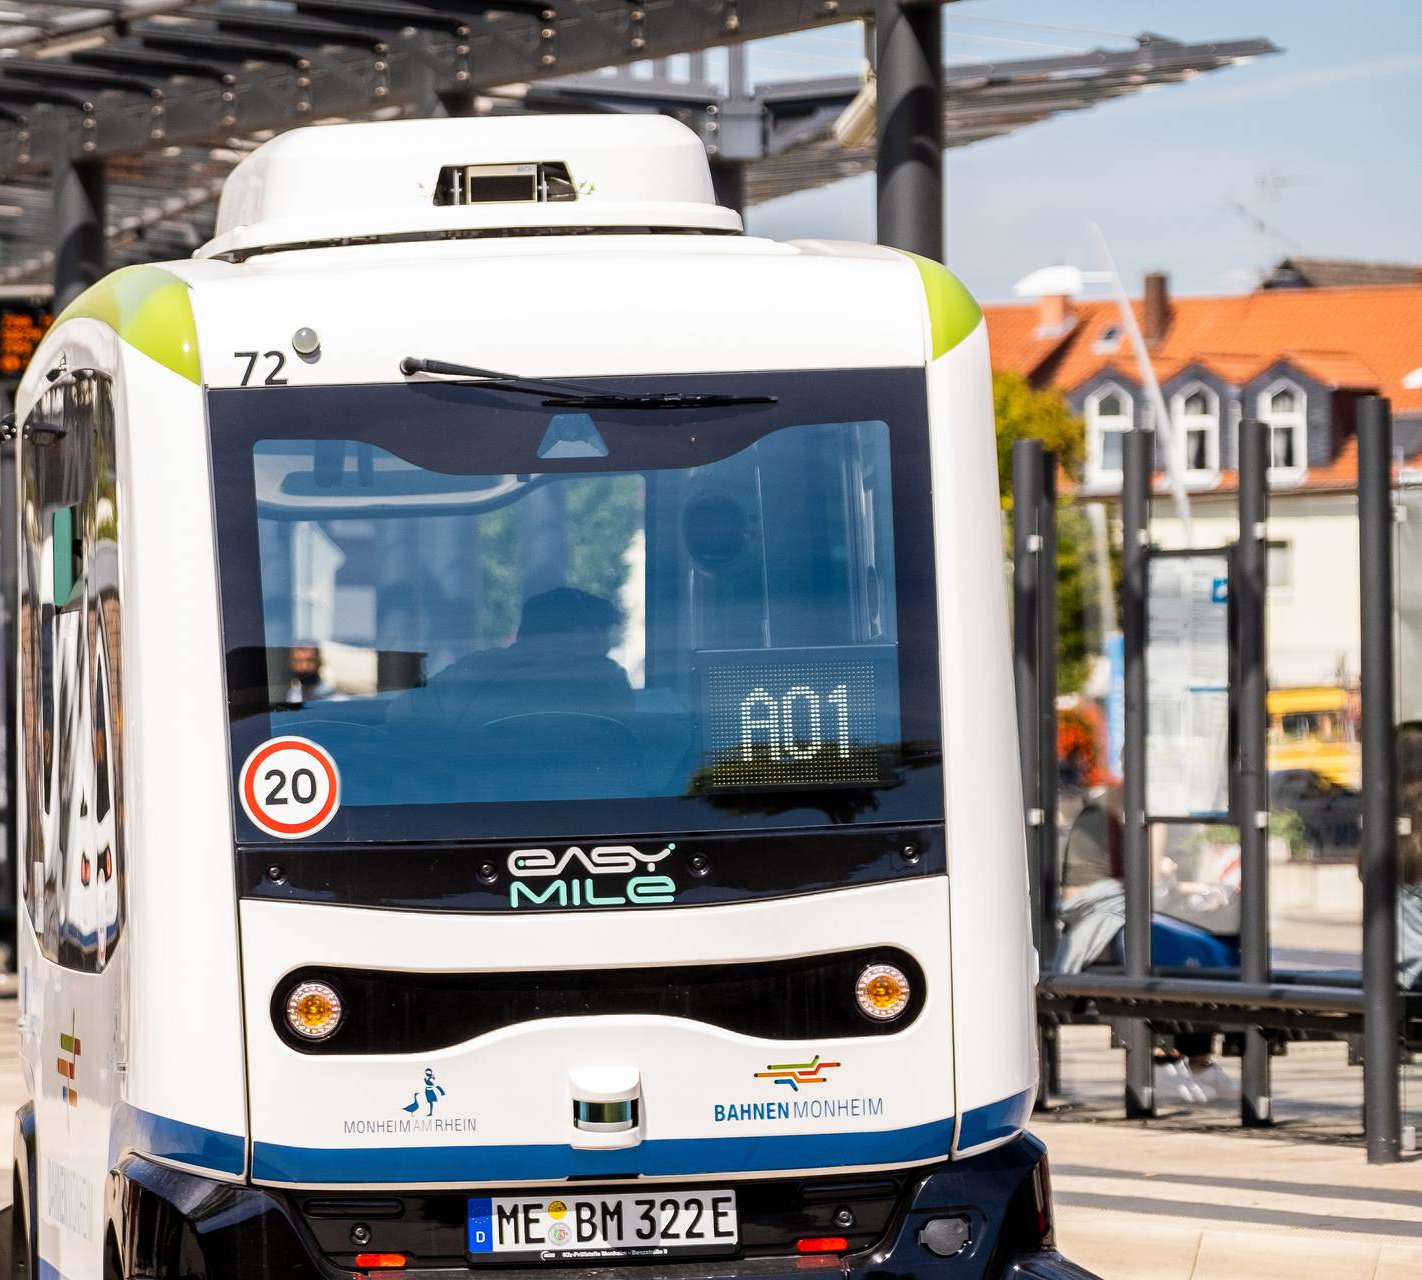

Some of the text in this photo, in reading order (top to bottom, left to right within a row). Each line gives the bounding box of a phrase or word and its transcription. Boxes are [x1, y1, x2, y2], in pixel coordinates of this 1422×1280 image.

[234, 351, 288, 386] 72
[741, 683, 850, 762] A01
[264, 768, 317, 806] 20
[475, 1231, 486, 1243] D
[496, 1196, 735, 1245] ME BM 322E
